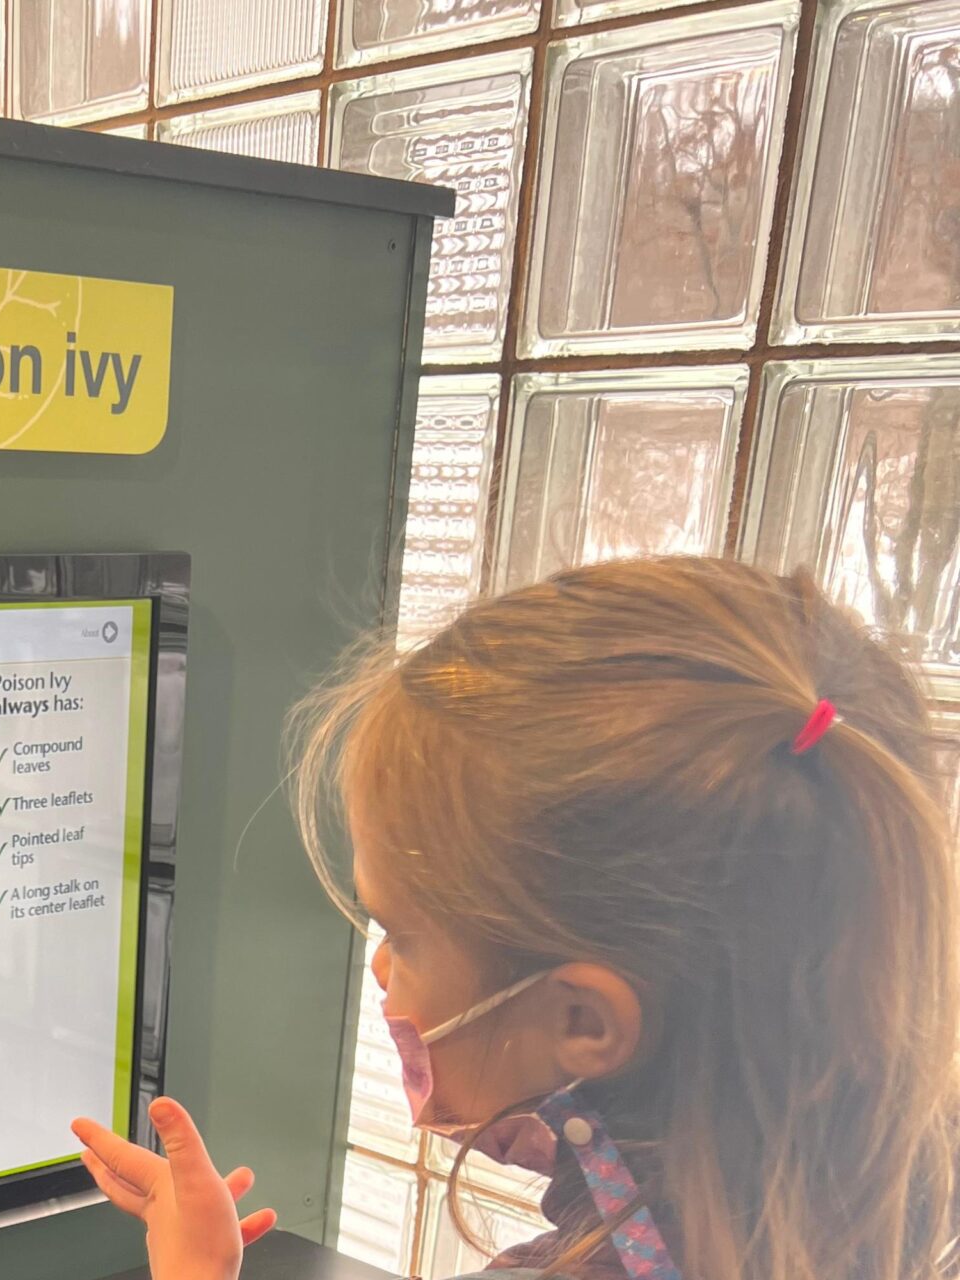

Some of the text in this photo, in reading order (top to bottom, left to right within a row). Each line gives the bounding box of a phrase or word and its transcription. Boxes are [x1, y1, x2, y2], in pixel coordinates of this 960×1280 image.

[64, 329, 143, 414] ivy
[50, 671, 72, 693] Ivy
[54, 694, 84, 712] has:
[13, 736, 83, 757] Compound
[13, 758, 51, 775] leaves
[12, 790, 93, 811] Three leaflets
[11, 826, 85, 848] Pointed leaf
[11, 851, 34, 869] tips
[10, 878, 99, 903] A long stalk on
[10, 894, 105, 920] its center leaflet
